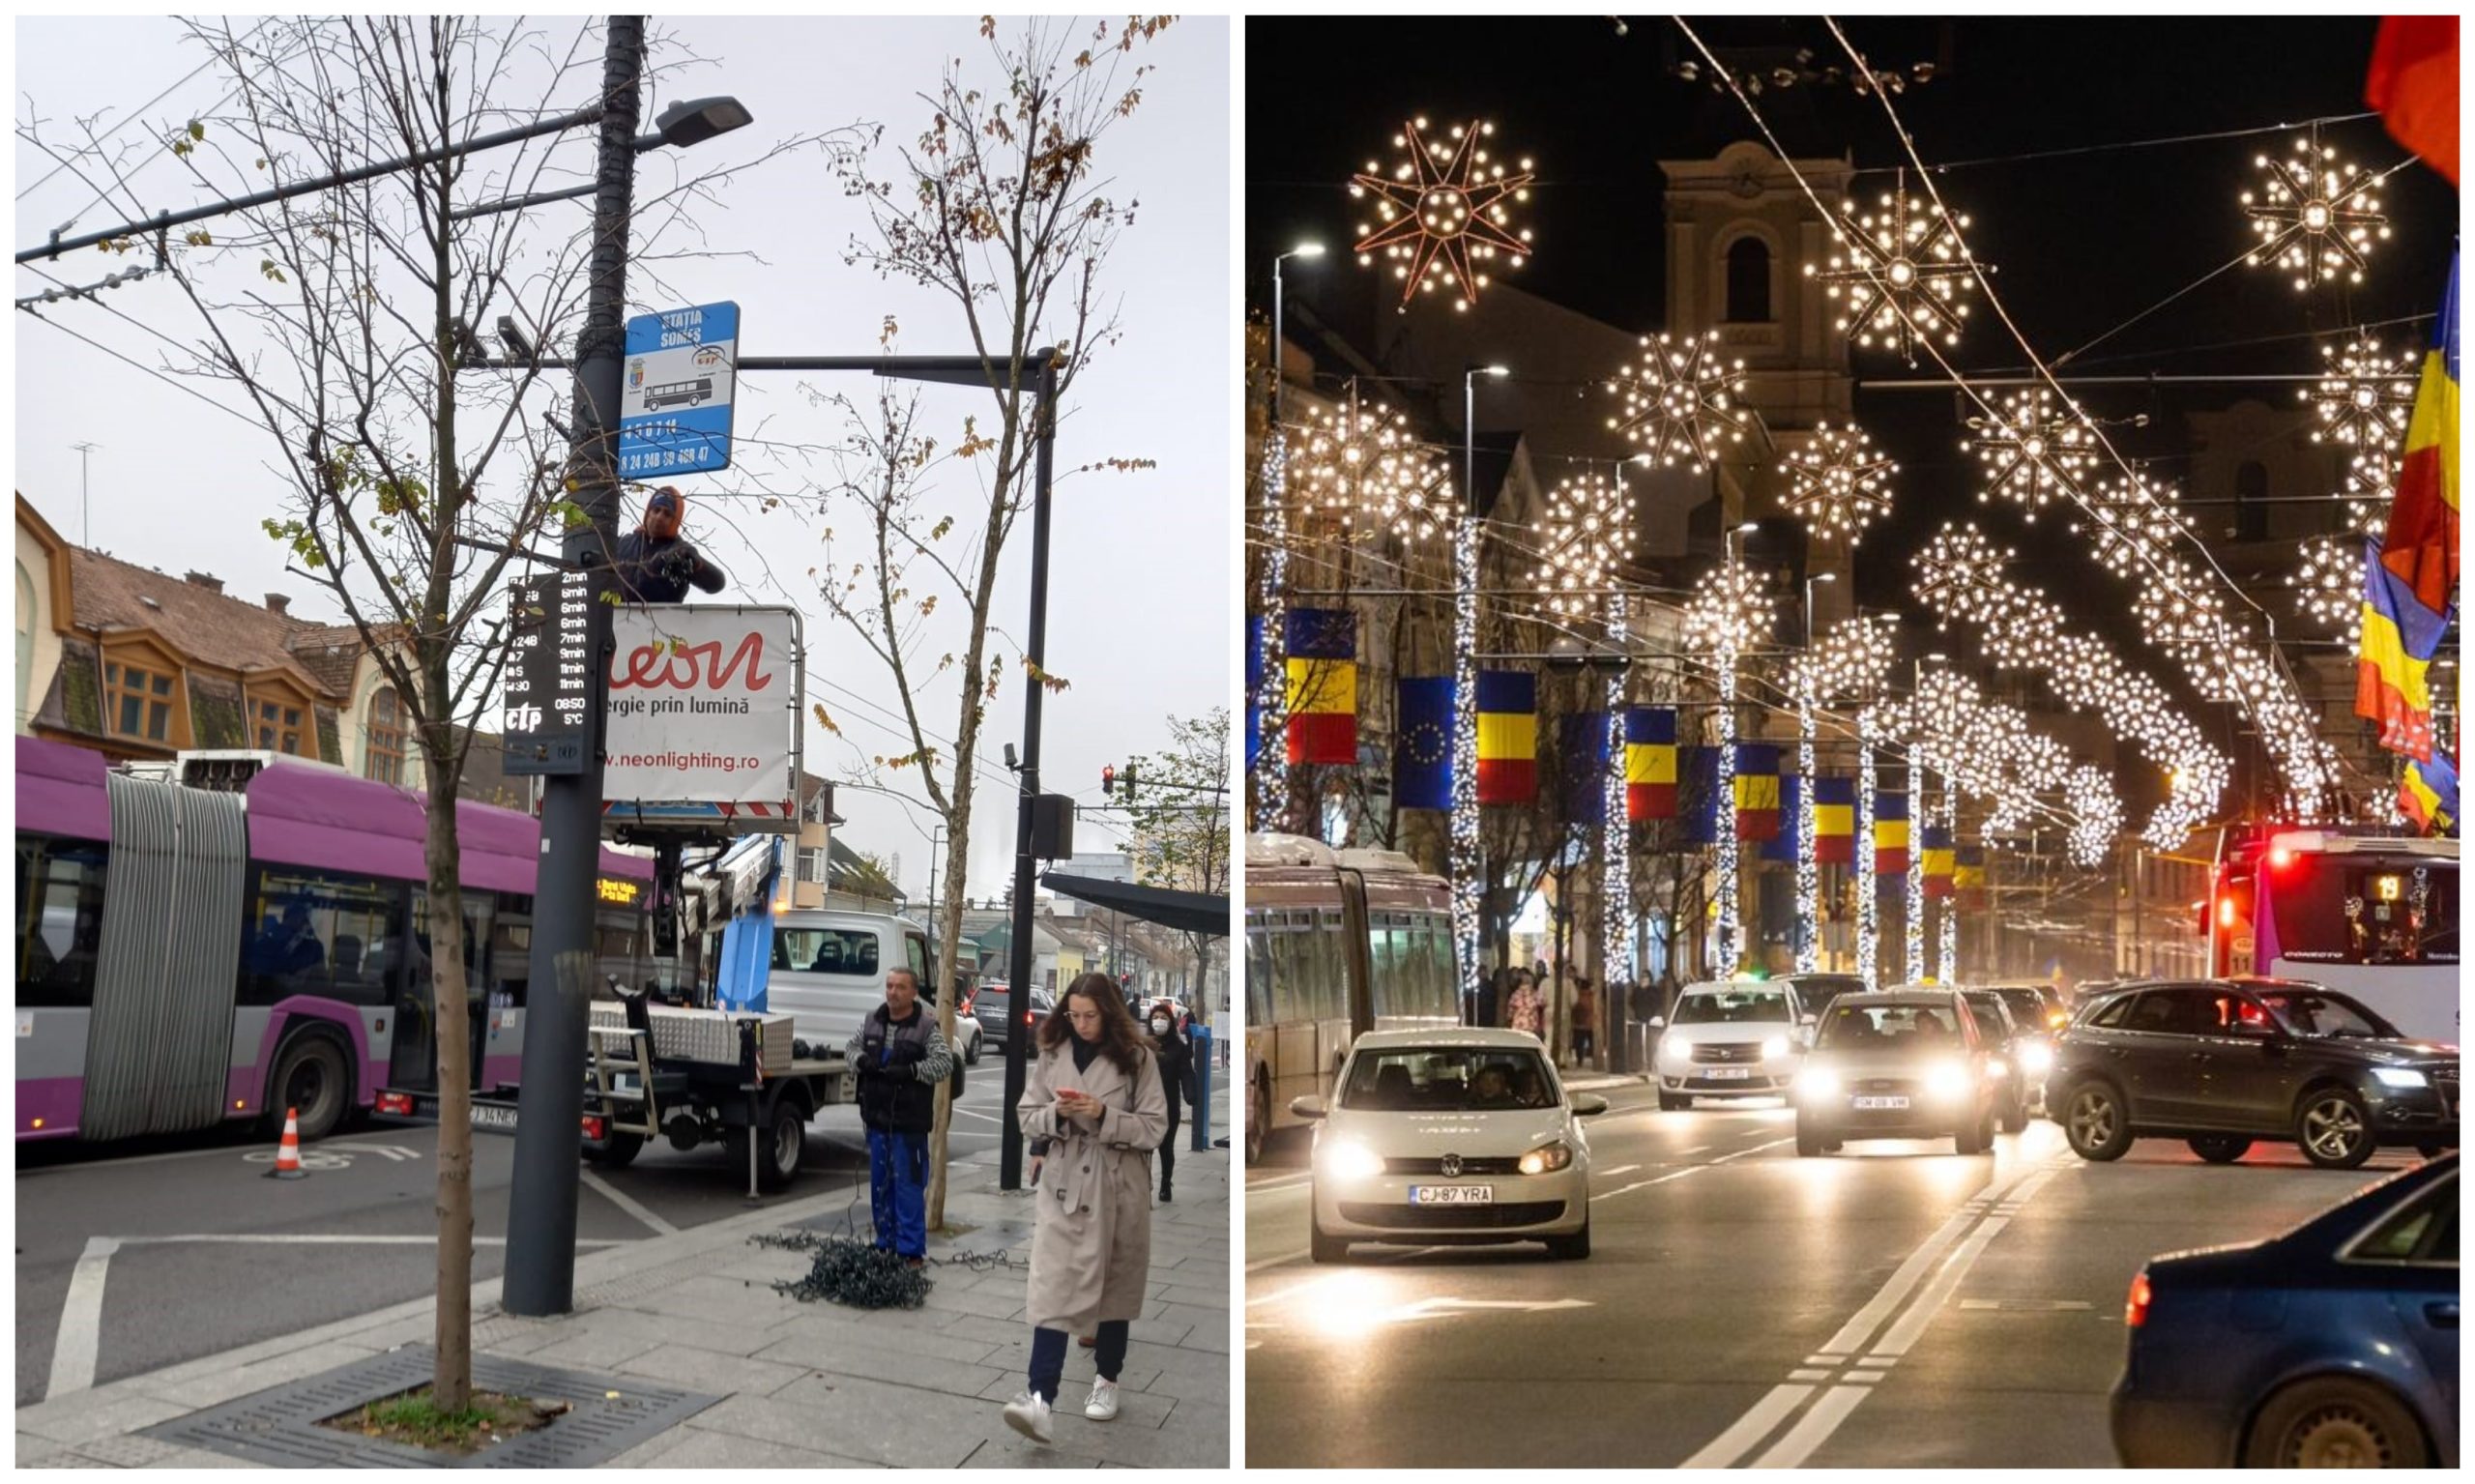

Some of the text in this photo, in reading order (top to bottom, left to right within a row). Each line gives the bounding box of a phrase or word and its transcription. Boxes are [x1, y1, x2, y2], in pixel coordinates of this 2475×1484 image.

[629, 452, 641, 470] 24
[698, 446, 710, 462] 47
[562, 571, 588, 583] 2min
[561, 586, 587, 598] 6min
[561, 600, 587, 614] 6min
[561, 616, 586, 629] 6min
[560, 631, 586, 645] 7min
[516, 647, 585, 662] 7 9min
[560, 662, 585, 675] 11min
[560, 678, 584, 689] 11min
[555, 698, 585, 710] 08:50
[651, 696, 684, 716] prin
[689, 695, 749, 714] lumină
[506, 702, 541, 733] ctp
[564, 713, 583, 725] 5°C
[2379, 875, 2399, 901] 19
[1419, 1187, 1490, 1202] CJ 87 YRA
